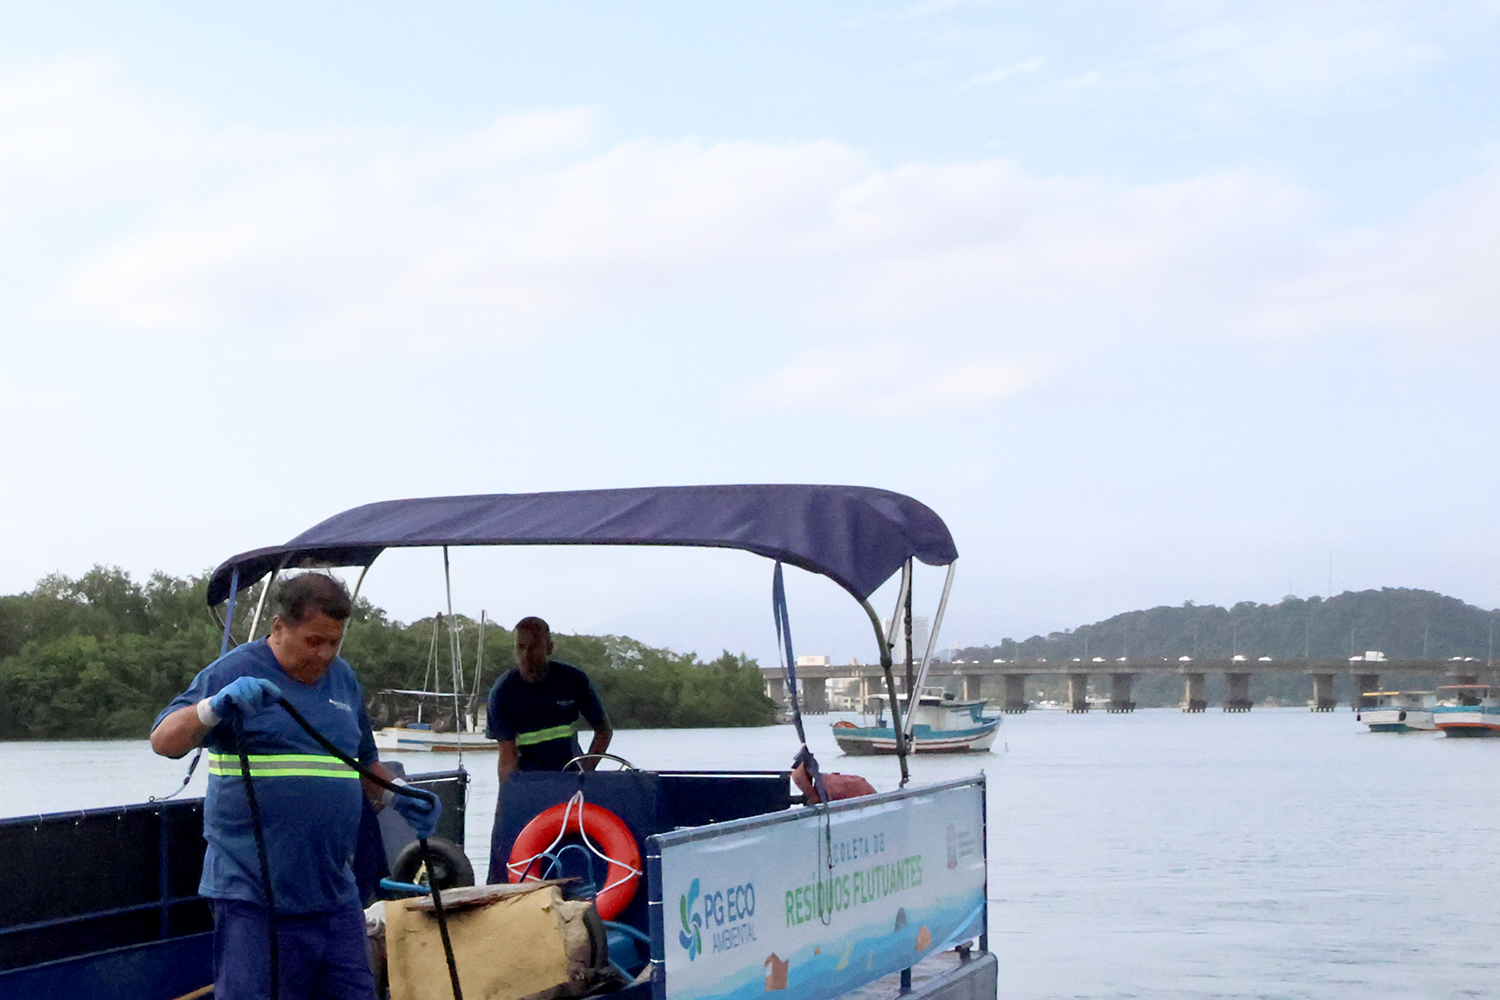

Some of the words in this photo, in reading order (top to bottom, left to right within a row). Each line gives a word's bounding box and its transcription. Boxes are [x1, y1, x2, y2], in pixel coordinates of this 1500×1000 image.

[833, 837, 870, 864] COLETA
[853, 854, 922, 906] FLUTUANTES
[704, 890, 725, 929] PG
[727, 882, 755, 923] ECO
